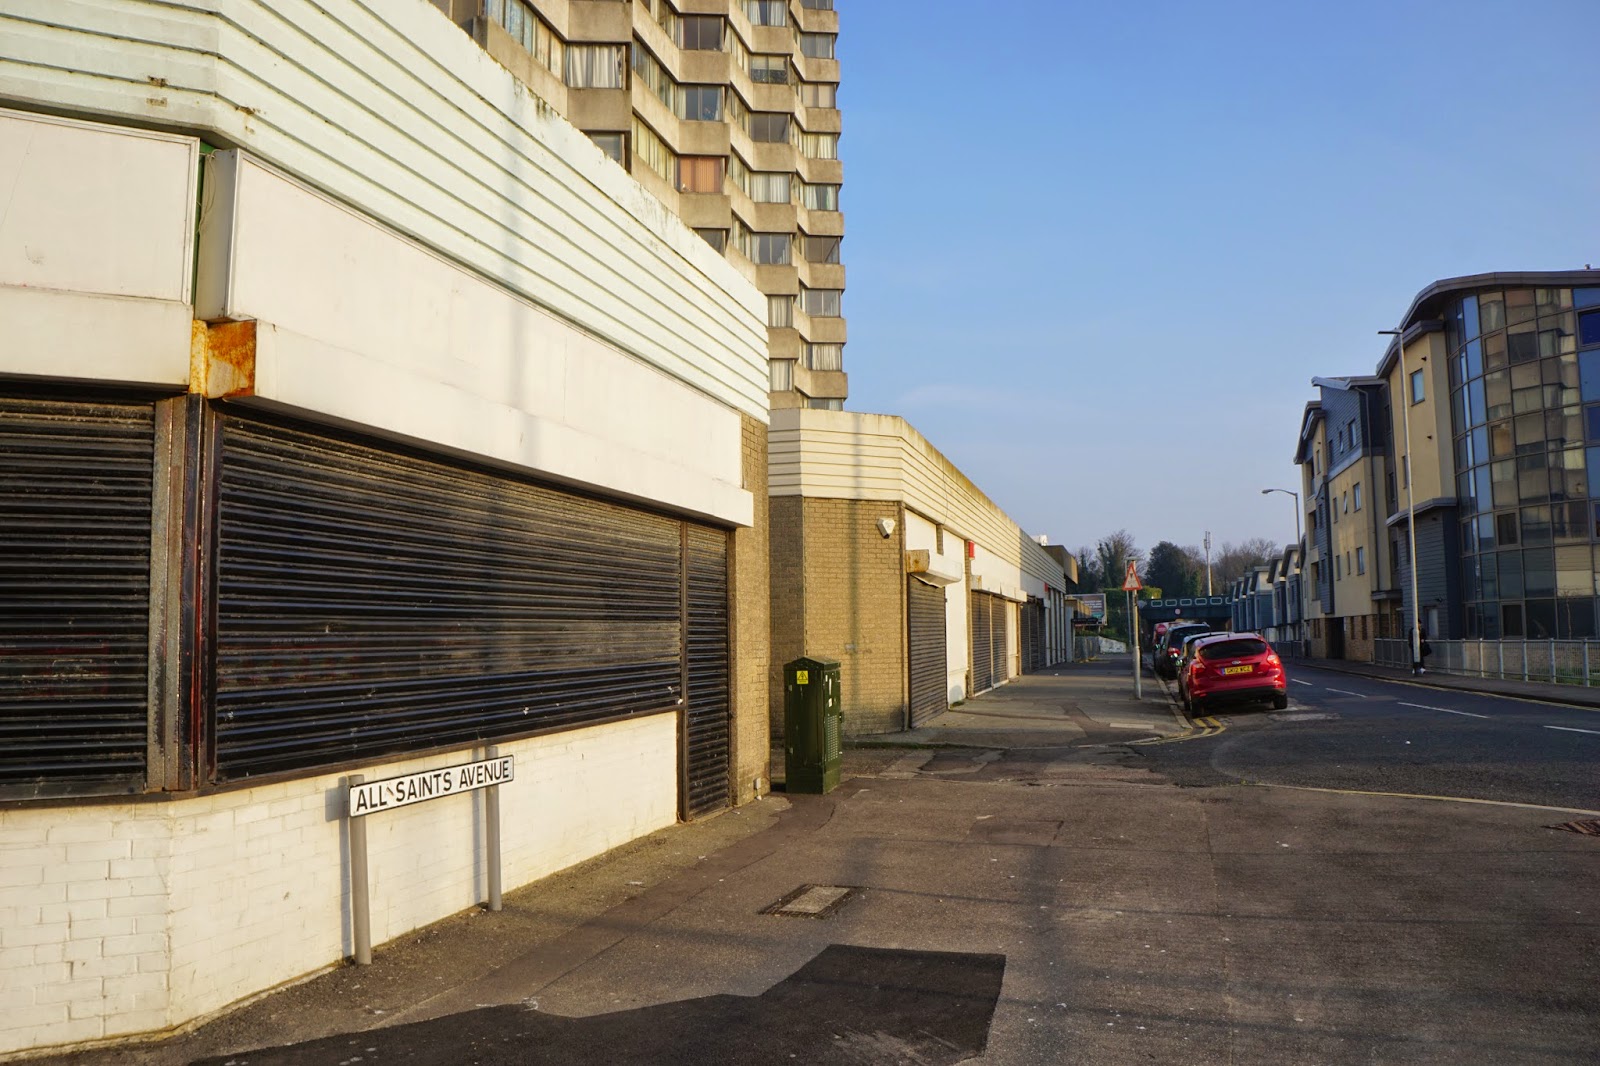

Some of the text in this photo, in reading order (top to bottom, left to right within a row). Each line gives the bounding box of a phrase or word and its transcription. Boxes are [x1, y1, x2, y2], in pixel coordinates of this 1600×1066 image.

[356, 760, 509, 812] ALL SAINTS AVENUE
